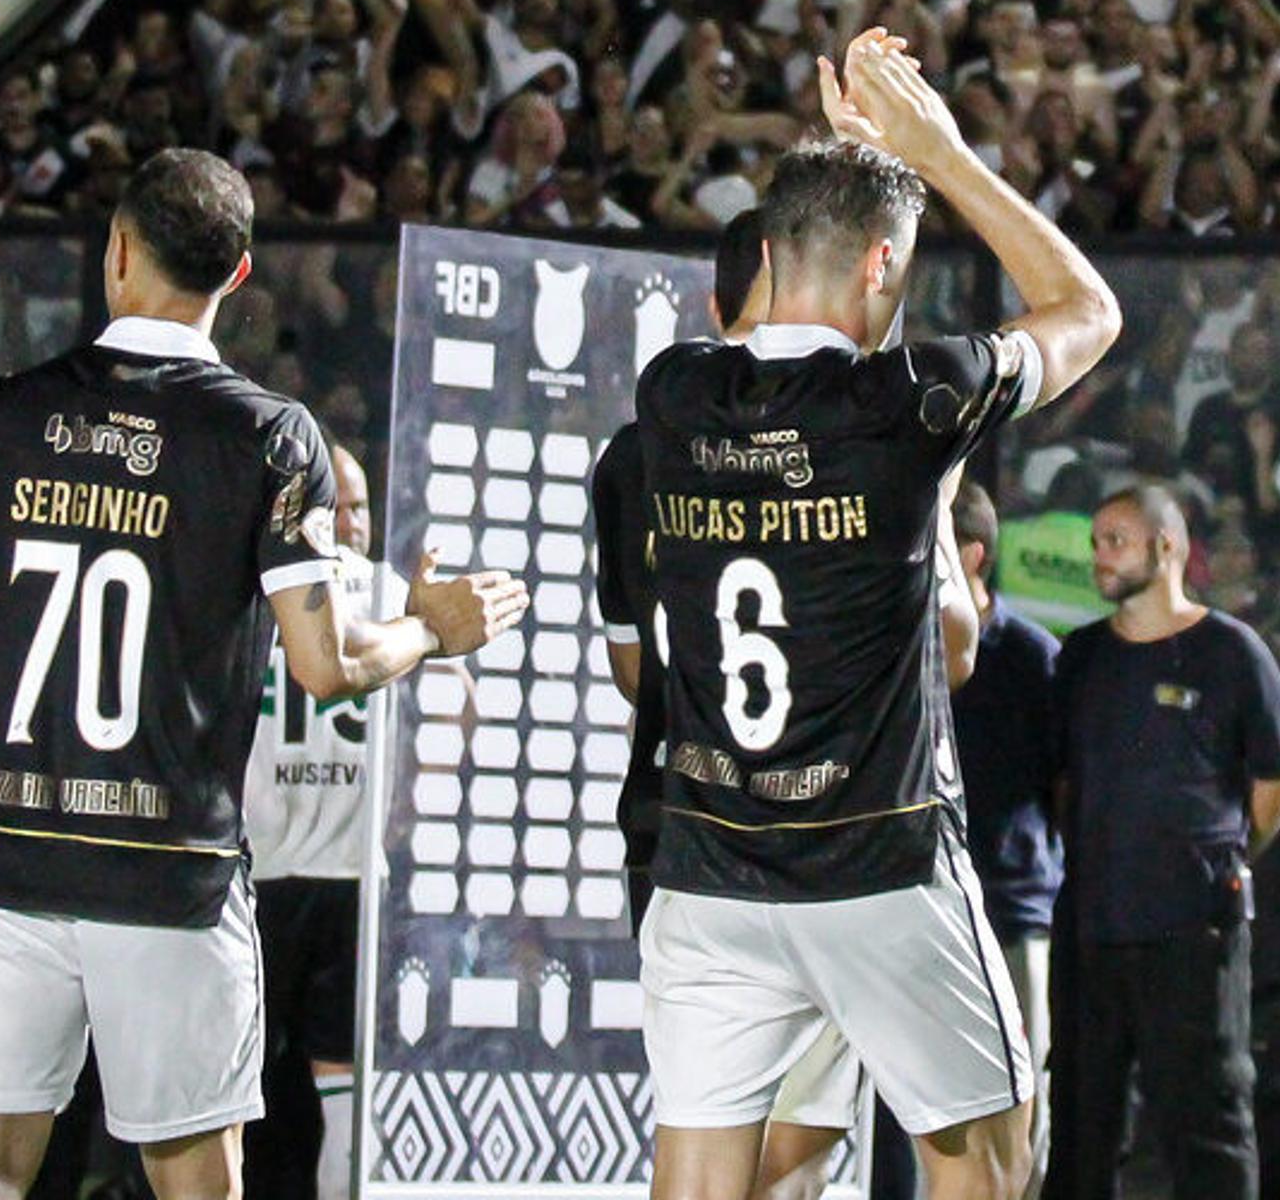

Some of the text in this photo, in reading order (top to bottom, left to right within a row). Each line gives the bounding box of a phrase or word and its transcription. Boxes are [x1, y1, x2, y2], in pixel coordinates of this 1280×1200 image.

[109, 411, 156, 431] VASCO
[750, 429, 799, 445] VASCO
[10, 478, 170, 539] SERGINHO
[654, 492, 868, 541] LUCAS PITON
[6, 538, 152, 751] 70
[714, 558, 792, 752] 6
